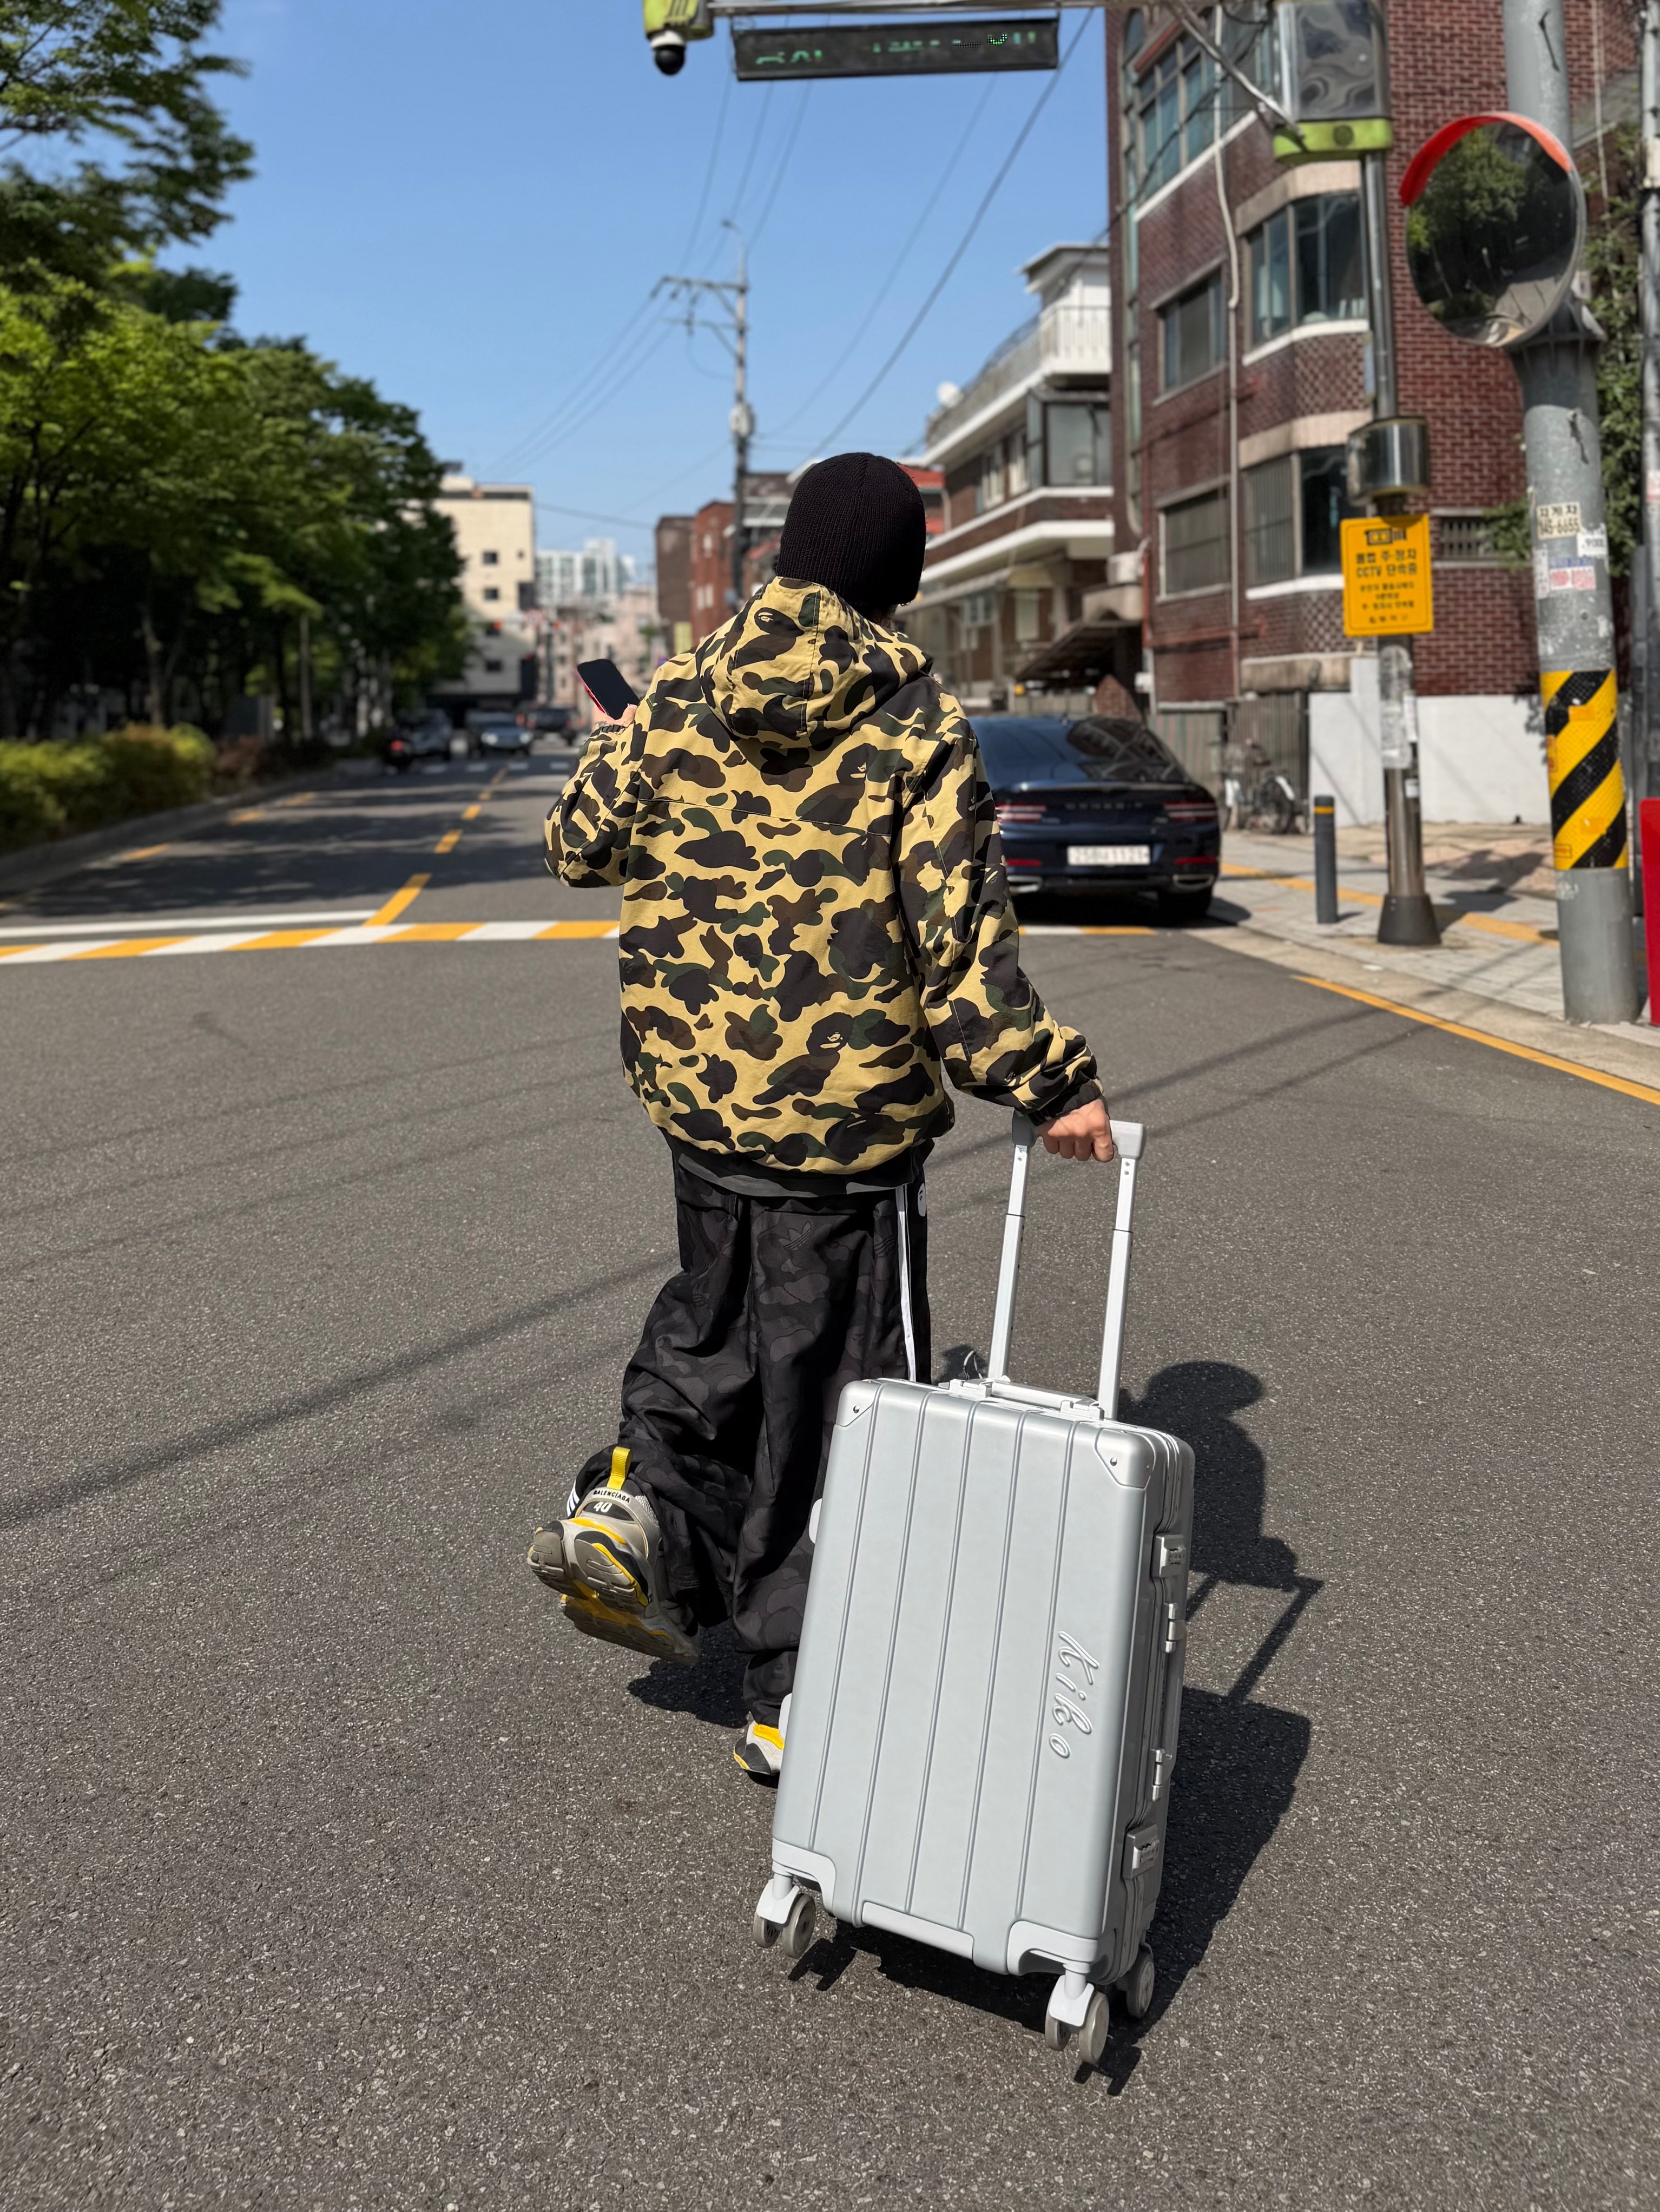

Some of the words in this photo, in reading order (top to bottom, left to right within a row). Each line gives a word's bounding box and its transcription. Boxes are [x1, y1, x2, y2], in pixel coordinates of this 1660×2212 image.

[1356, 566, 1381, 578] CCTV
[593, 1490, 630, 1503] BALENCIAGA
[594, 1502, 612, 1513] 40
[1049, 1631, 1099, 1758] Kiko
